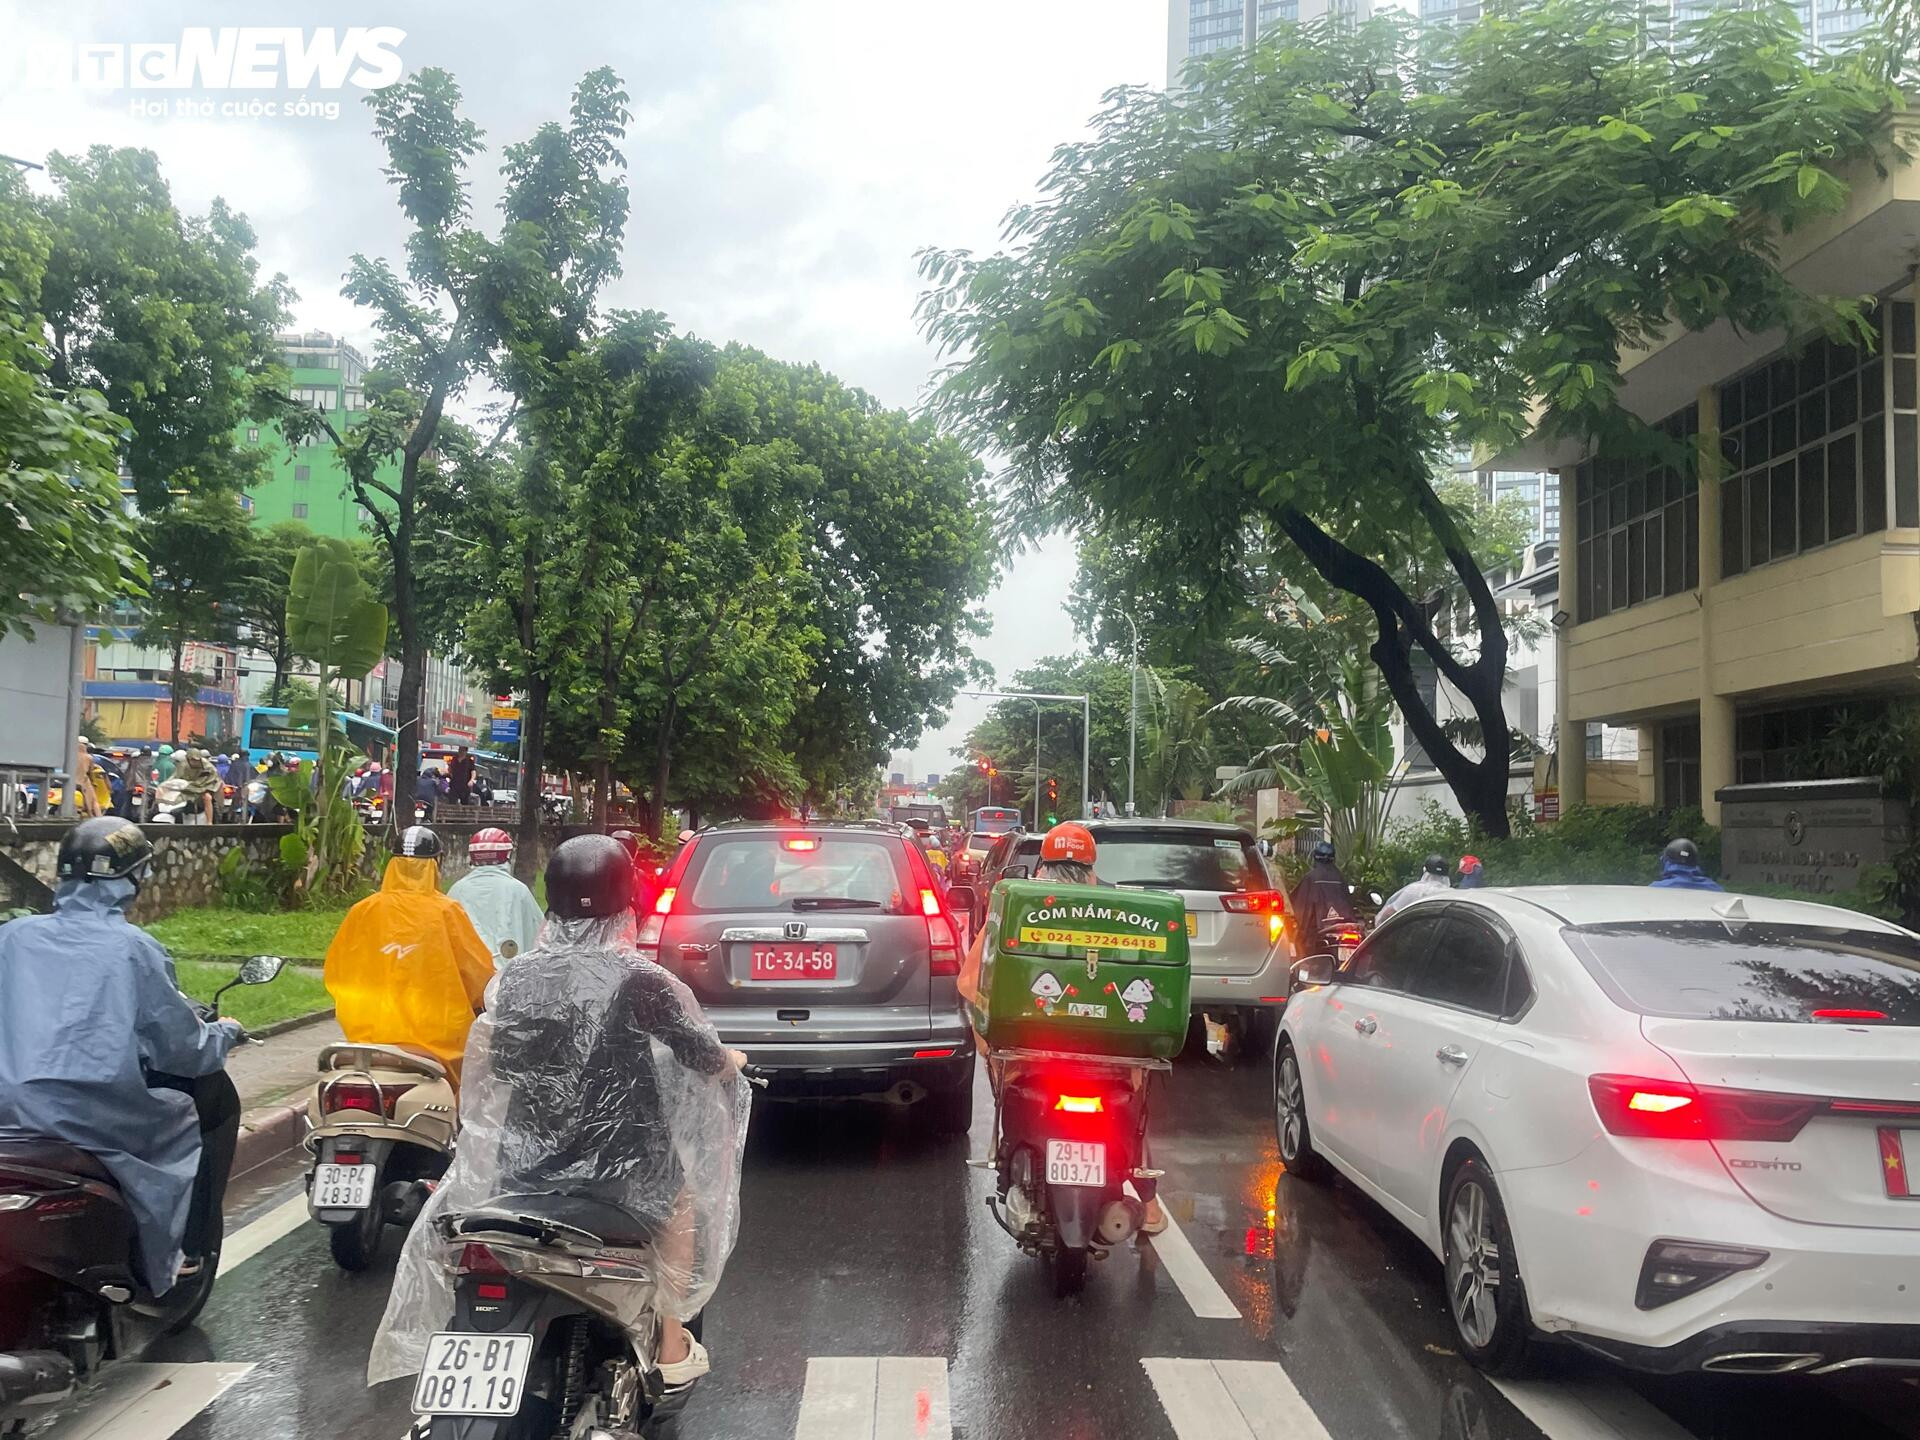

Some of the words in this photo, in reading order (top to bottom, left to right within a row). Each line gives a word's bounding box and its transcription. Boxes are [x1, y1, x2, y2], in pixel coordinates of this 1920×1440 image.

[1071, 903, 1112, 920] NẮM
[1115, 910, 1160, 932] AOKI
[1047, 932, 1073, 943] 024
[1084, 934, 1119, 946] 3724
[1121, 937, 1157, 949] 6418
[755, 951, 833, 971] TC-34-58
[1055, 1142, 1097, 1163] 29-L1
[323, 1167, 366, 1185] 30-P4
[1050, 1162, 1101, 1183] 803.71
[320, 1186, 363, 1205] 4838
[438, 1338, 516, 1372] 26-B1
[420, 1375, 516, 1410] 081.19
